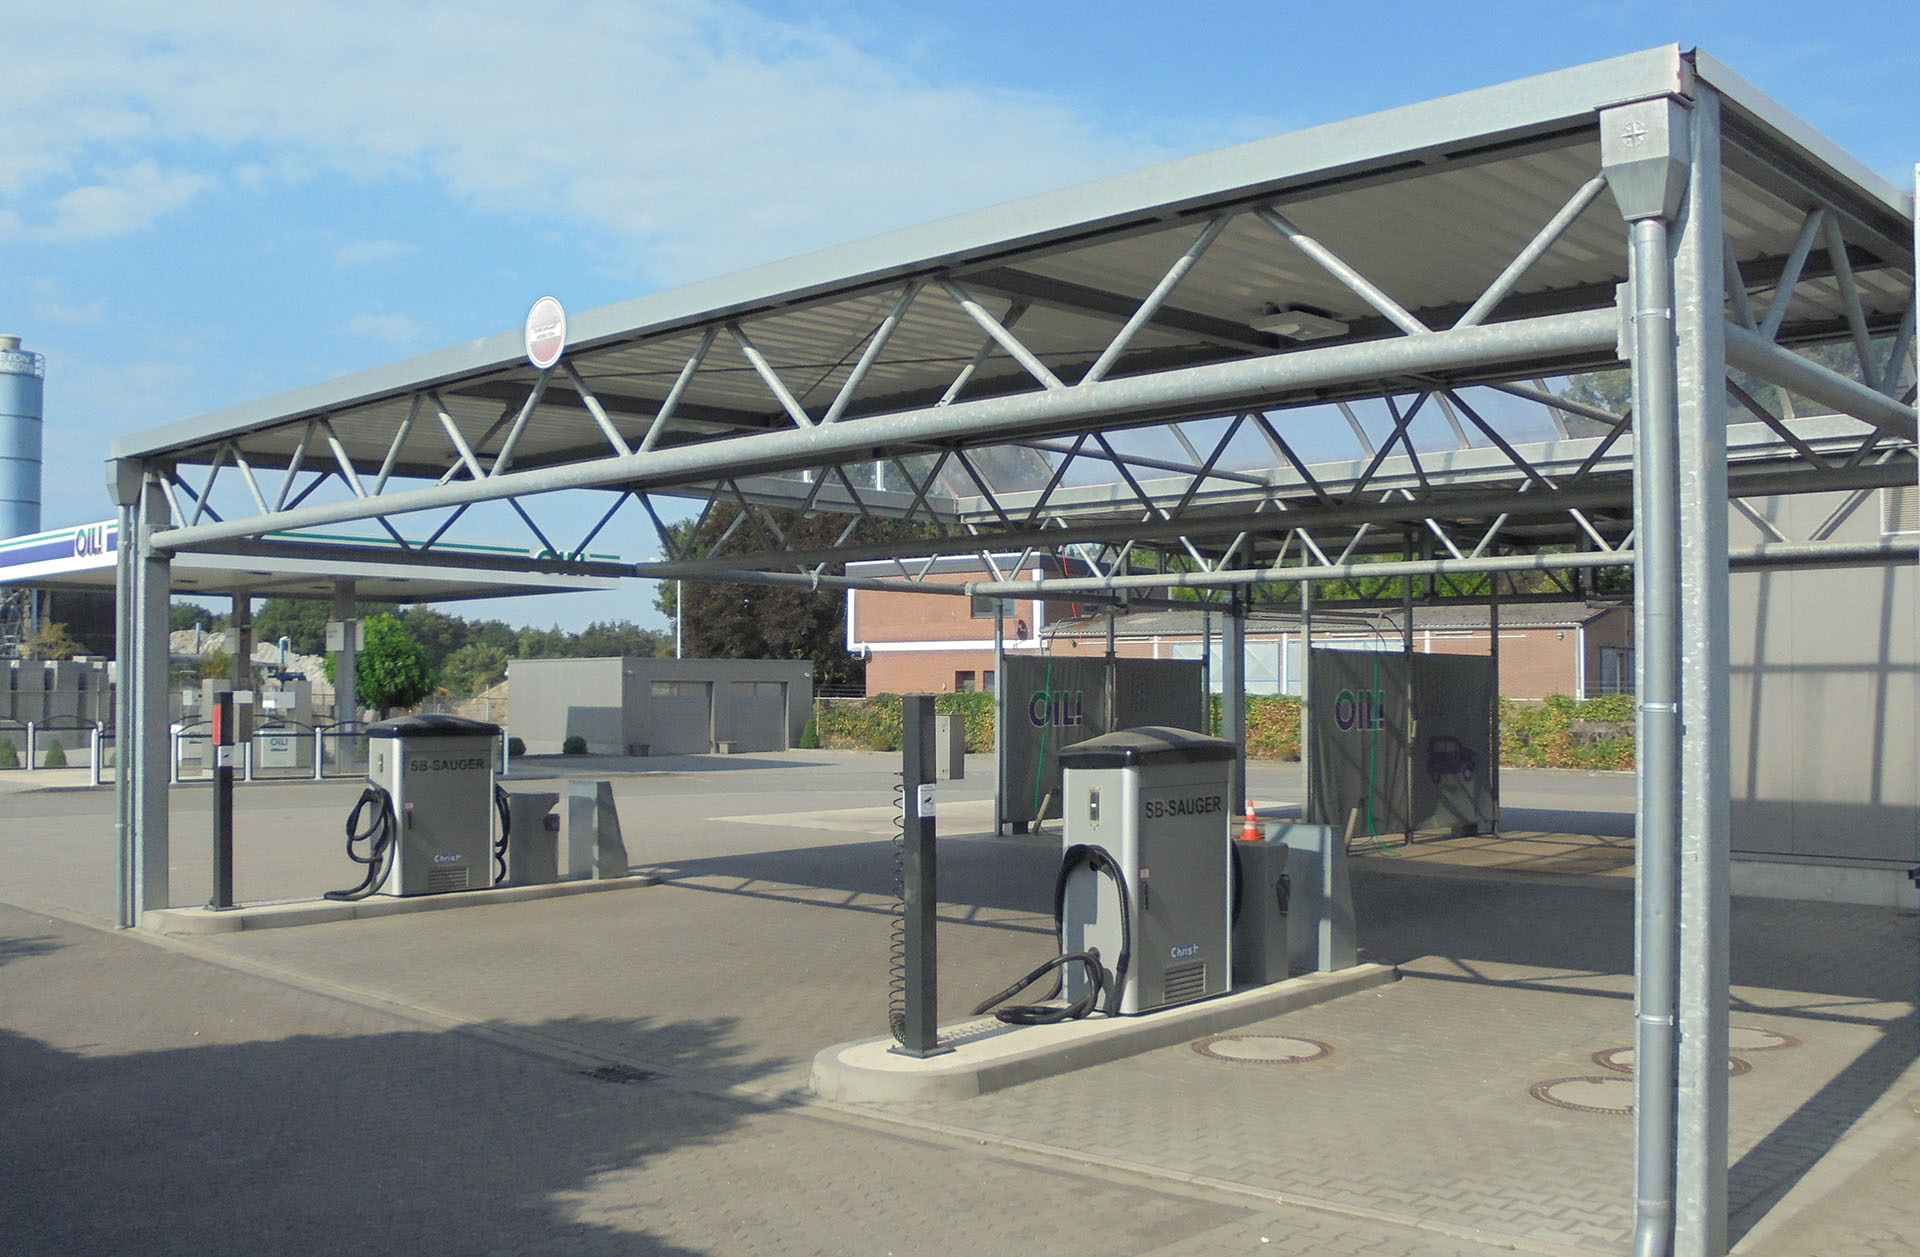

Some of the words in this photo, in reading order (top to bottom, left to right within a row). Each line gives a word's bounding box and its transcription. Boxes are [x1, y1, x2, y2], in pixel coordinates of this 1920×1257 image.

[76, 525, 103, 558] OIL!
[1028, 690, 1083, 728] OIL!
[1335, 688, 1385, 732] OIL!
[410, 758, 485, 772] SB-SAUGER
[1145, 796, 1222, 819] SB-SAUGER
[1170, 943, 1200, 959] Christ
